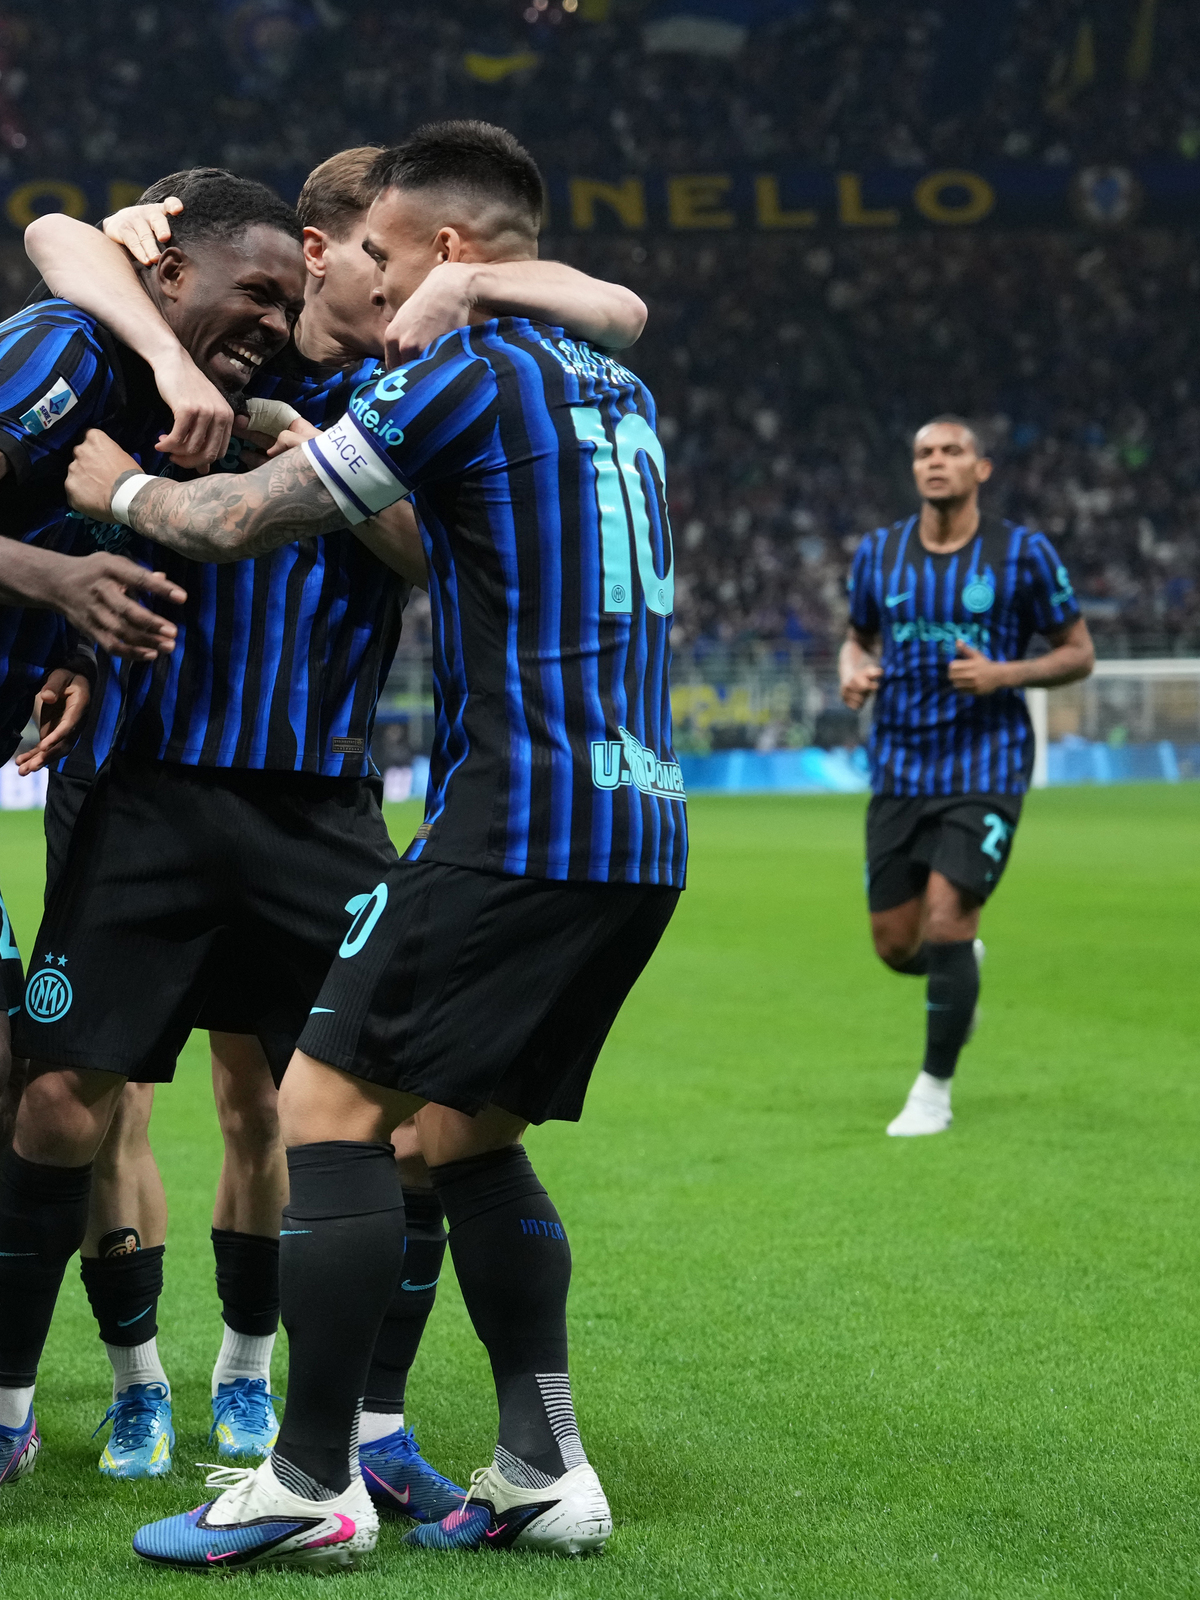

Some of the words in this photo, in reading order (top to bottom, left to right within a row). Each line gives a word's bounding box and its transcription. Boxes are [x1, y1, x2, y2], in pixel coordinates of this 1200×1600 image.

[542, 169, 998, 231] NELLO
[352, 397, 405, 446] ate.io
[327, 423, 368, 475] EACE
[570, 406, 675, 618] 10
[981, 811, 1013, 863] 2
